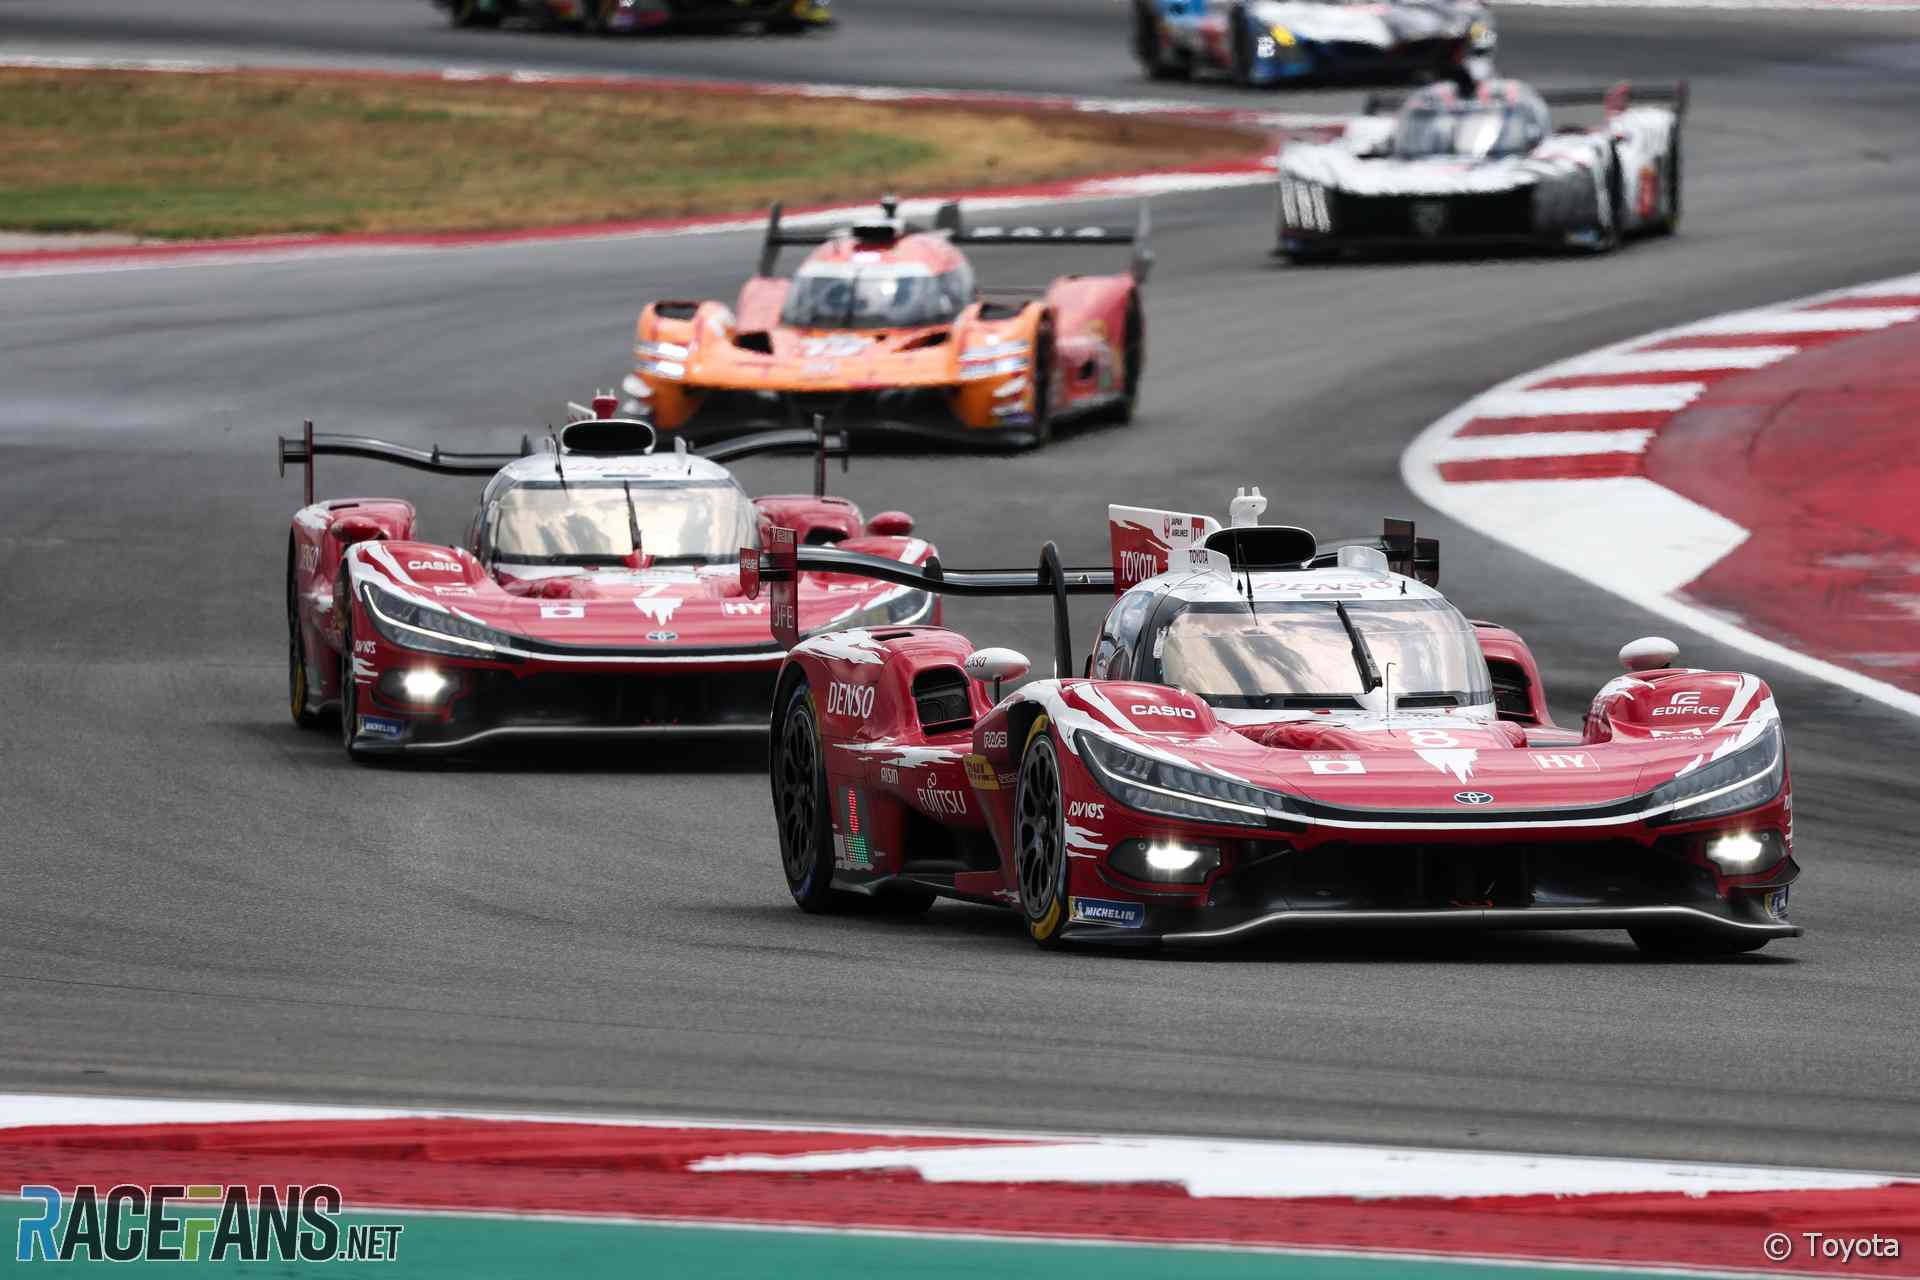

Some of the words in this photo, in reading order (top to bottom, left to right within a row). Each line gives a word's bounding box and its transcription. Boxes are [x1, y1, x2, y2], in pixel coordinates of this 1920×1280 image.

[1188, 550, 1209, 564] TOYOTA
[408, 560, 463, 573] CASIO
[1120, 550, 1158, 582] TOYOTA
[1255, 577, 1393, 591] DENSO
[723, 602, 767, 615] HY
[774, 605, 793, 629] JFE
[827, 681, 875, 720] DENSO
[1130, 704, 1197, 719] CASIO
[1651, 705, 1720, 717] EDIFICE
[1407, 728, 1460, 748] 8
[1535, 754, 1586, 769] HY
[916, 787, 967, 820] FUJITSU
[1084, 906, 1136, 922] MICHELIN
